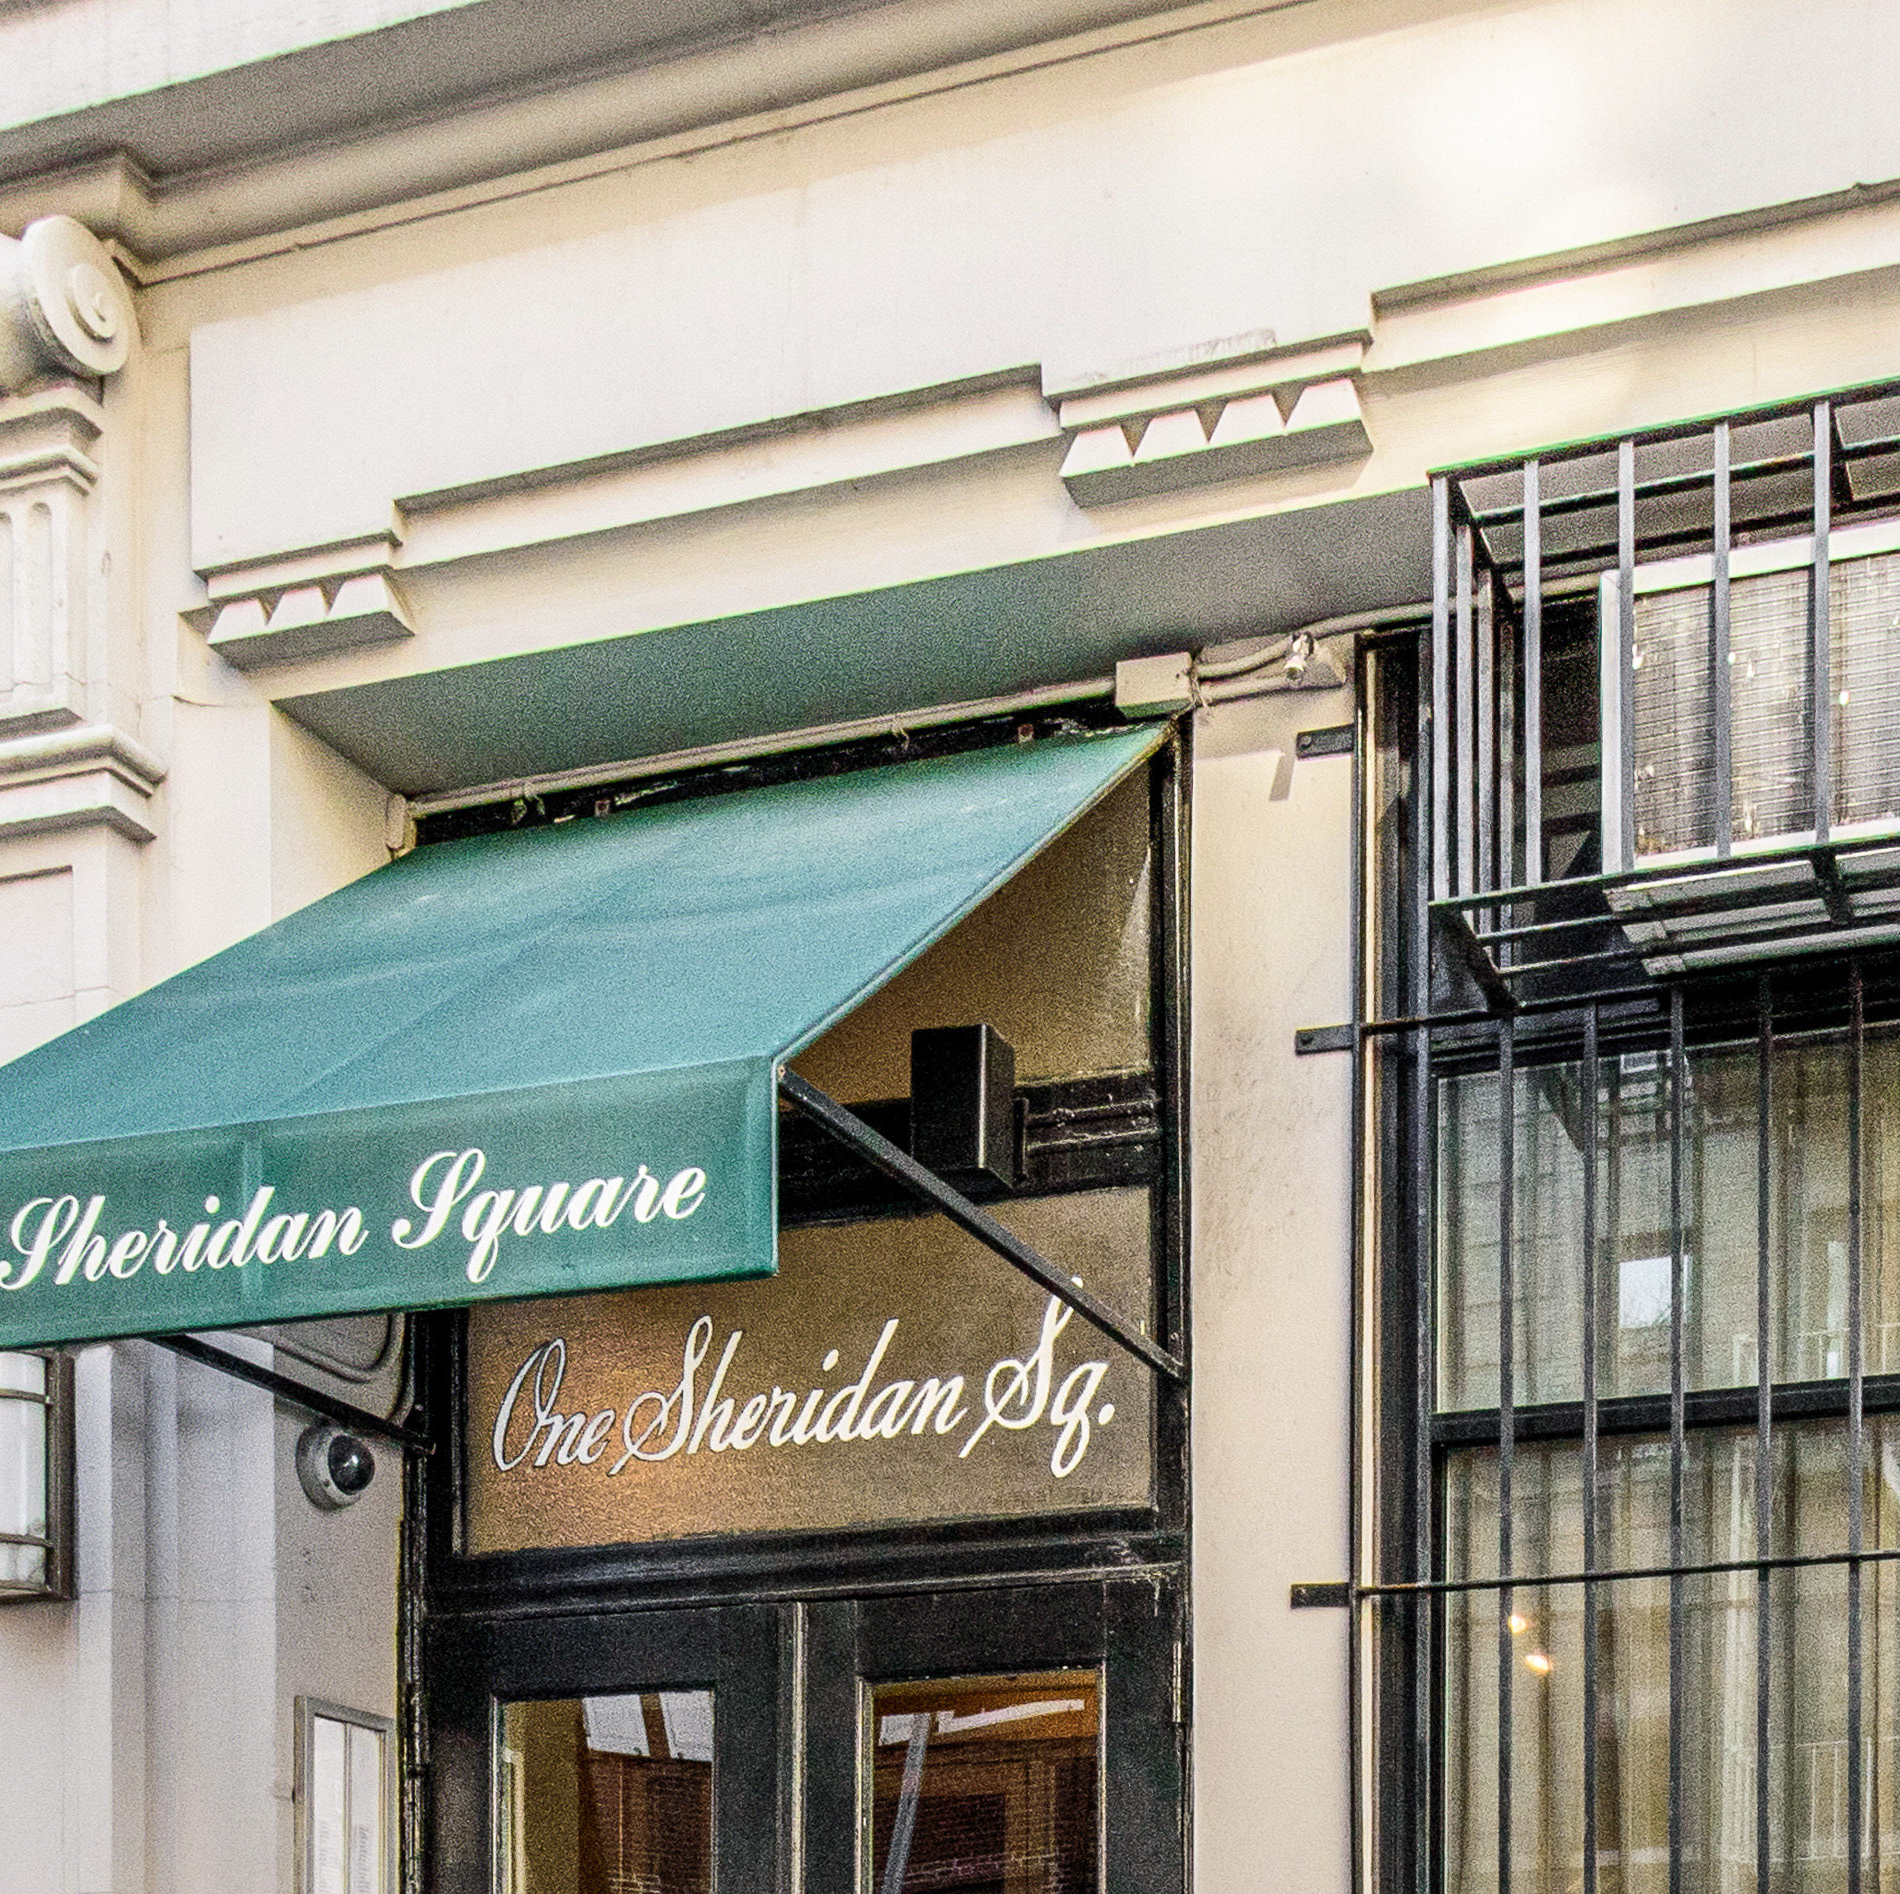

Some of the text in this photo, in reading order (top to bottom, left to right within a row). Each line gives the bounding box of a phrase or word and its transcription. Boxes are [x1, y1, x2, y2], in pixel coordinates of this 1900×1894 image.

[391, 1147, 707, 1284] Square
[491, 1275, 1116, 1479] One Sheridan Sq.
